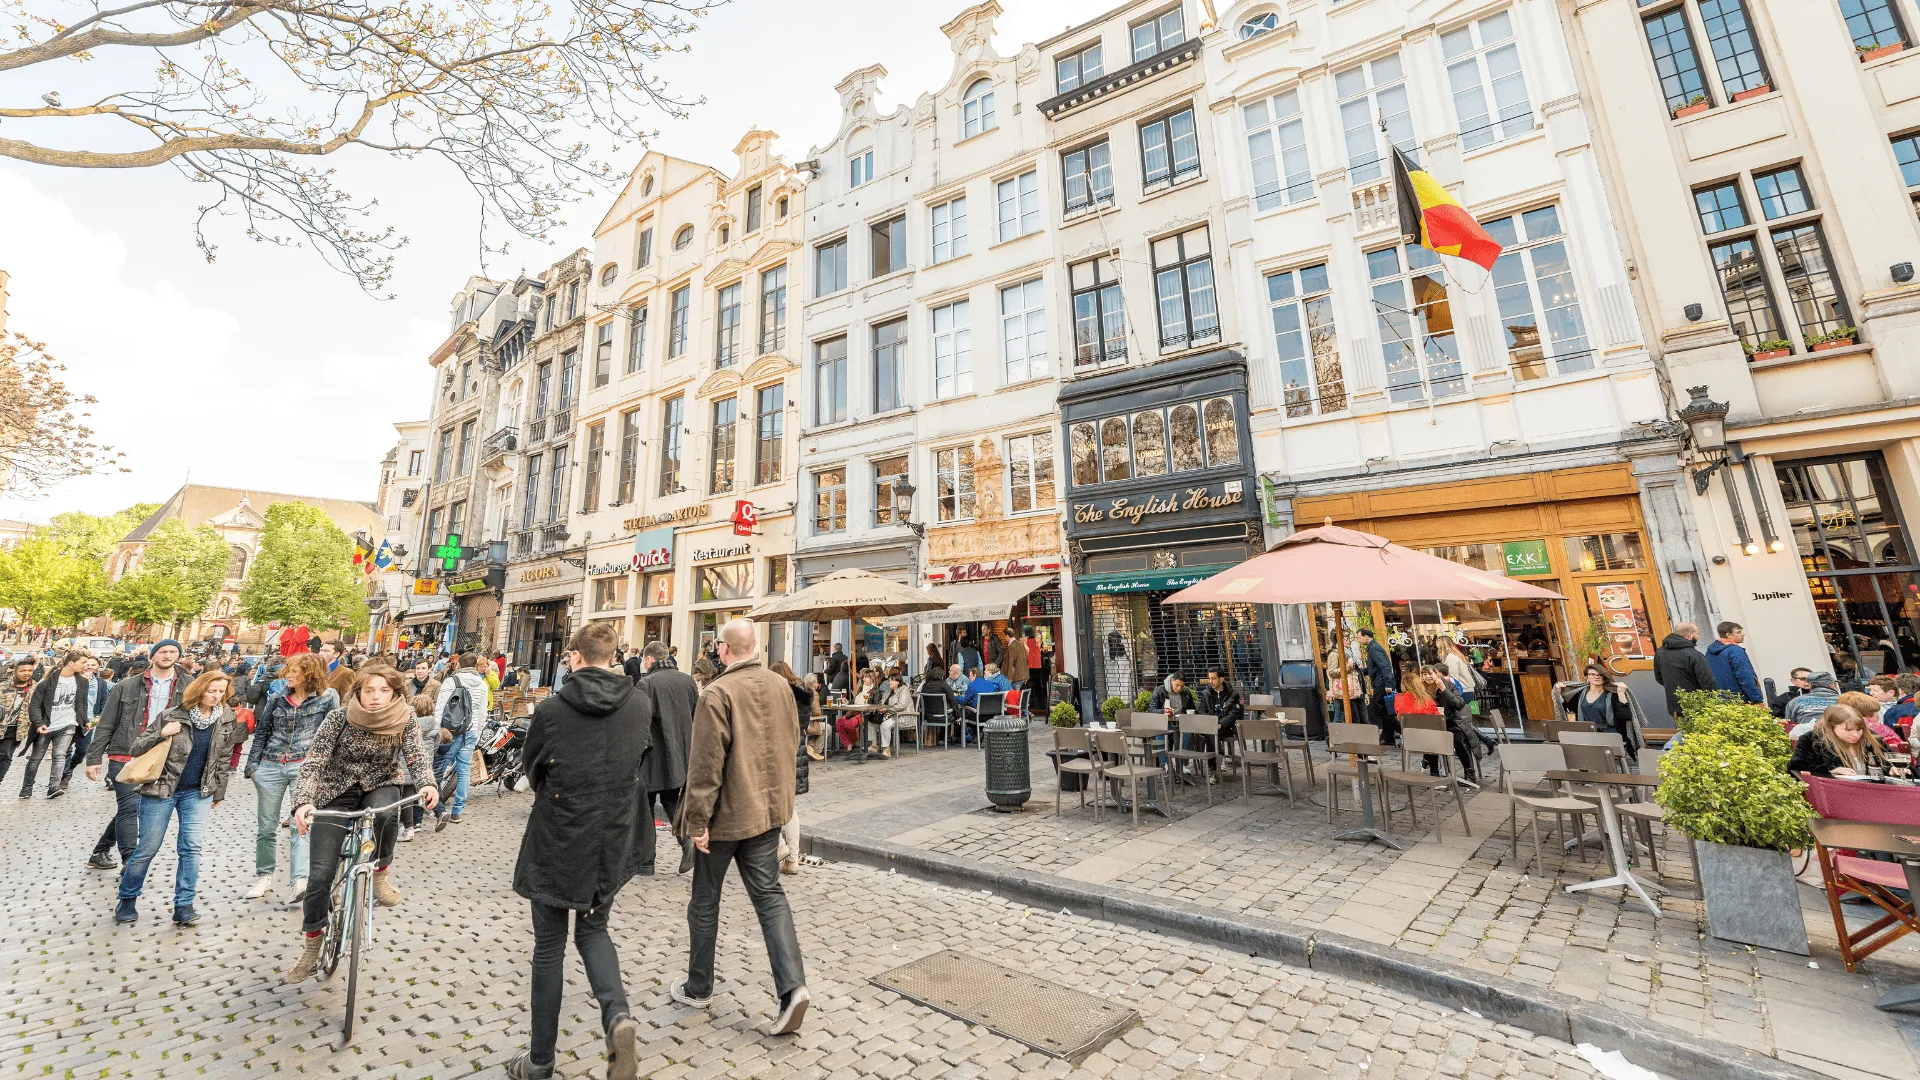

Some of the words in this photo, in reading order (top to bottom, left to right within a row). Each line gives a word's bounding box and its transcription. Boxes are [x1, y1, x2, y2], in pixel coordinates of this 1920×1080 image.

[1206, 420, 1234, 431] TAILOR
[1137, 449, 1164, 459] LONDON
[742, 504, 754, 522] Q
[1074, 503, 1104, 524] The
[1108, 493, 1179, 525] English
[1182, 487, 1243, 509] House
[624, 514, 656, 530] STELLA
[672, 503, 709, 521] ARTOIS
[693, 543, 749, 561] Restaurant
[630, 548, 670, 572] Quick
[520, 565, 560, 581] AGORA
[588, 563, 629, 575] Hamburger
[949, 565, 967, 581] The
[968, 560, 1004, 580] Purple
[1004, 559, 1036, 576] Rose
[1107, 582, 1130, 592] English
[1166, 578, 1178, 586] The
[1751, 591, 1794, 601] Jupiler
[1264, 621, 1273, 629] 95
